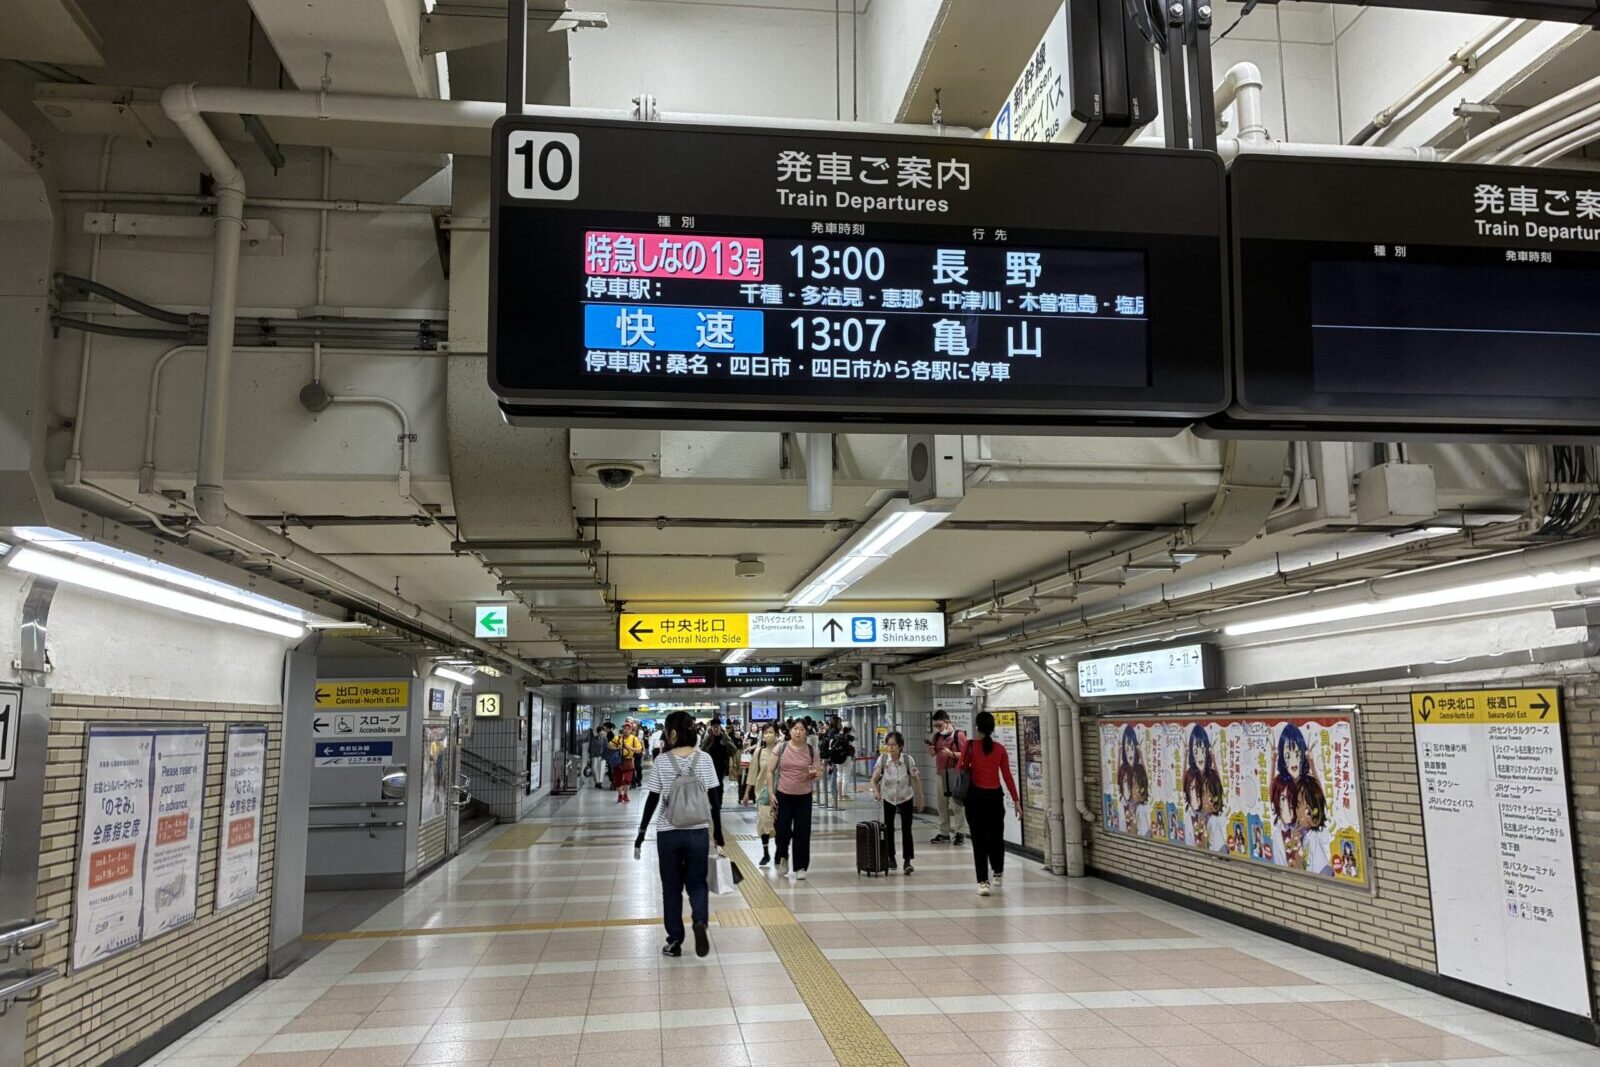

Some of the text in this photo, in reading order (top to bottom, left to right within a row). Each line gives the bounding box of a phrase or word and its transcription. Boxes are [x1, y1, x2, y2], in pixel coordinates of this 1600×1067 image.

[1014, 66, 1052, 134] Shinkansen
[514, 140, 573, 191] 10
[776, 150, 970, 191] 発車ご案内
[776, 188, 949, 212] Train Departures
[811, 221, 865, 236] 発車時刻
[1474, 219, 1519, 237] Train
[586, 235, 1042, 288] 特急しなの13号 13:00 長野
[1505, 250, 1552, 263] 発車時刻
[790, 316, 887, 352] 13:07
[932, 318, 1042, 358] 亀山
[660, 618, 726, 633] 中央北口
[882, 618, 929, 632] 新幹線
[661, 633, 741, 644] Central North Side
[882, 633, 938, 643] Shinkansen
[1114, 660, 1153, 676] のりばご案内
[335, 696, 400, 705] Central-North Exit
[479, 697, 496, 713] 13
[1438, 697, 1475, 710] 中央北口
[1487, 695, 1517, 710] 桜通口
[359, 715, 400, 725] スロープ
[1488, 726, 1549, 735] JRセントラルタワーズ
[162, 764, 198, 777] Please reserve
[160, 782, 186, 797] your seat
[1437, 780, 1460, 788] タクシー
[1494, 784, 1542, 794] JRゲートタワー
[159, 801, 165, 812] in
[1428, 797, 1475, 809] JRハイウェイバス
[91, 818, 141, 846] 全席指定席
[1500, 842, 1520, 852] 地下鉄
[1503, 861, 1556, 877] 市バスターミナル
[1517, 883, 1544, 893] タクシー
